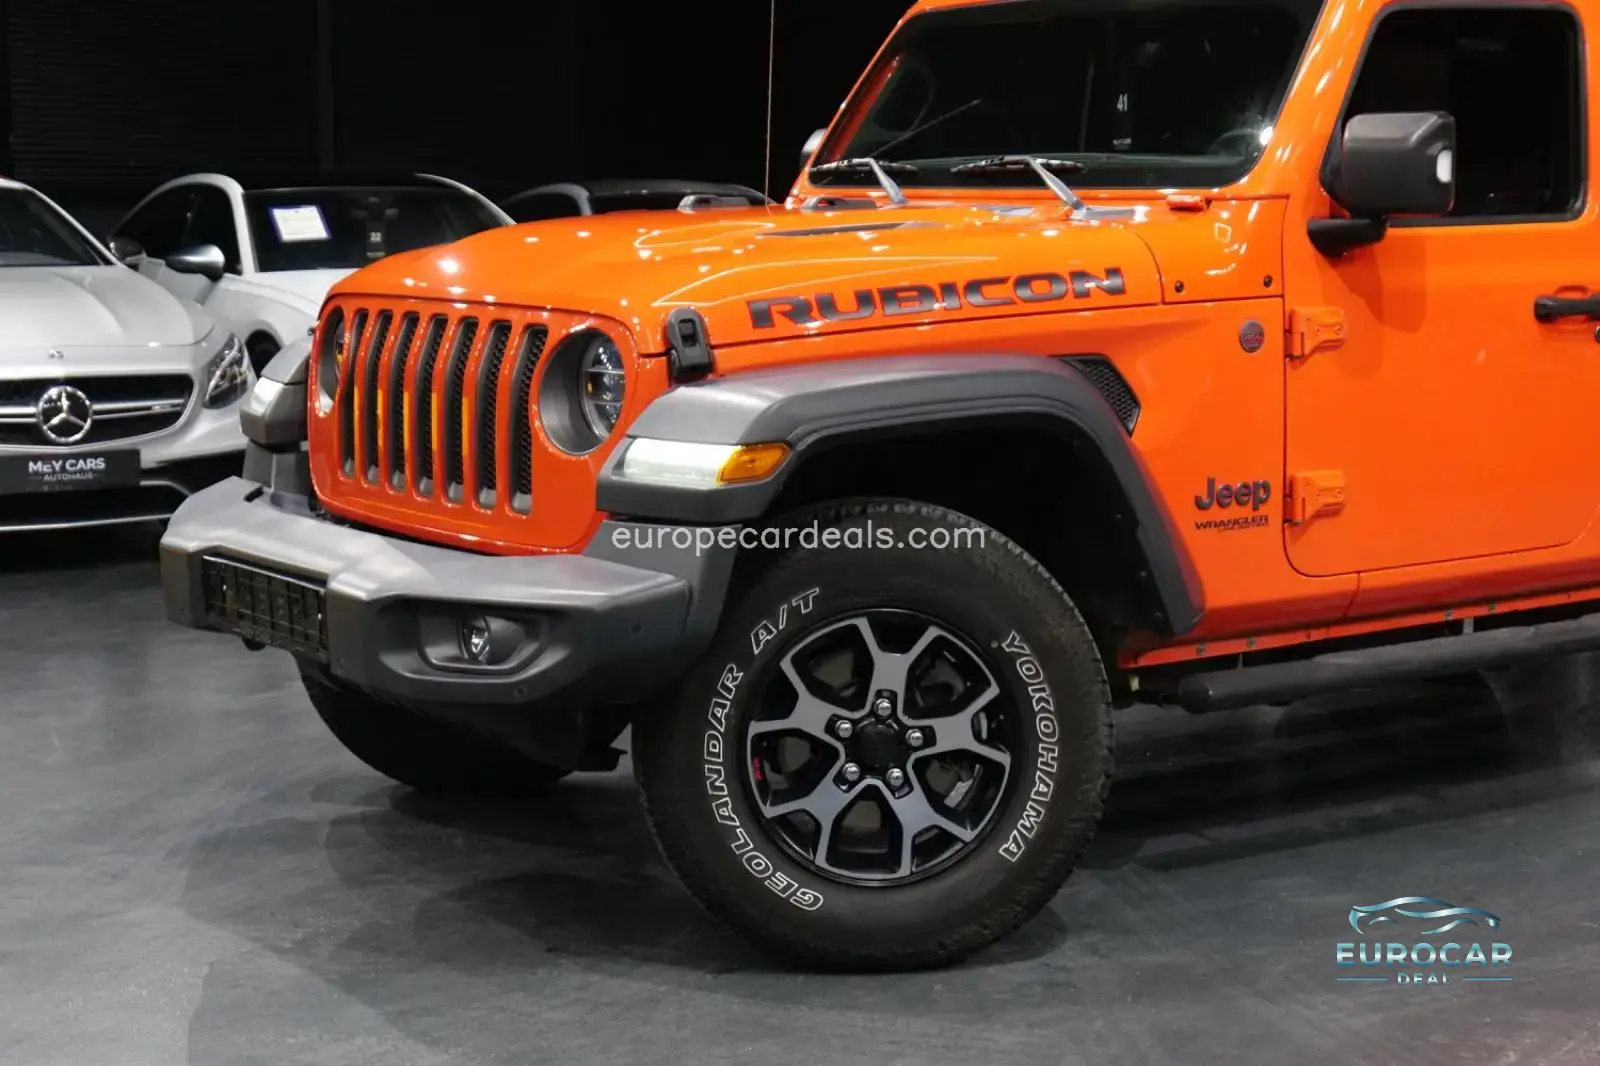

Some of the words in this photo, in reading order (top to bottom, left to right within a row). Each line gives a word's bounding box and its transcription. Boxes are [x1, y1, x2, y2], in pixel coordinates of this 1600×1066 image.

[746, 267, 1127, 329] RUBICON
[44, 472, 93, 480] AUTOHAUS
[65, 457, 106, 471] CARS
[1195, 477, 1271, 511] Jeep
[1195, 515, 1268, 529] WRANGLER
[750, 587, 820, 655] A/T
[999, 630, 1059, 862] YOKOHAMA
[704, 663, 824, 911] GEOLANDAR
